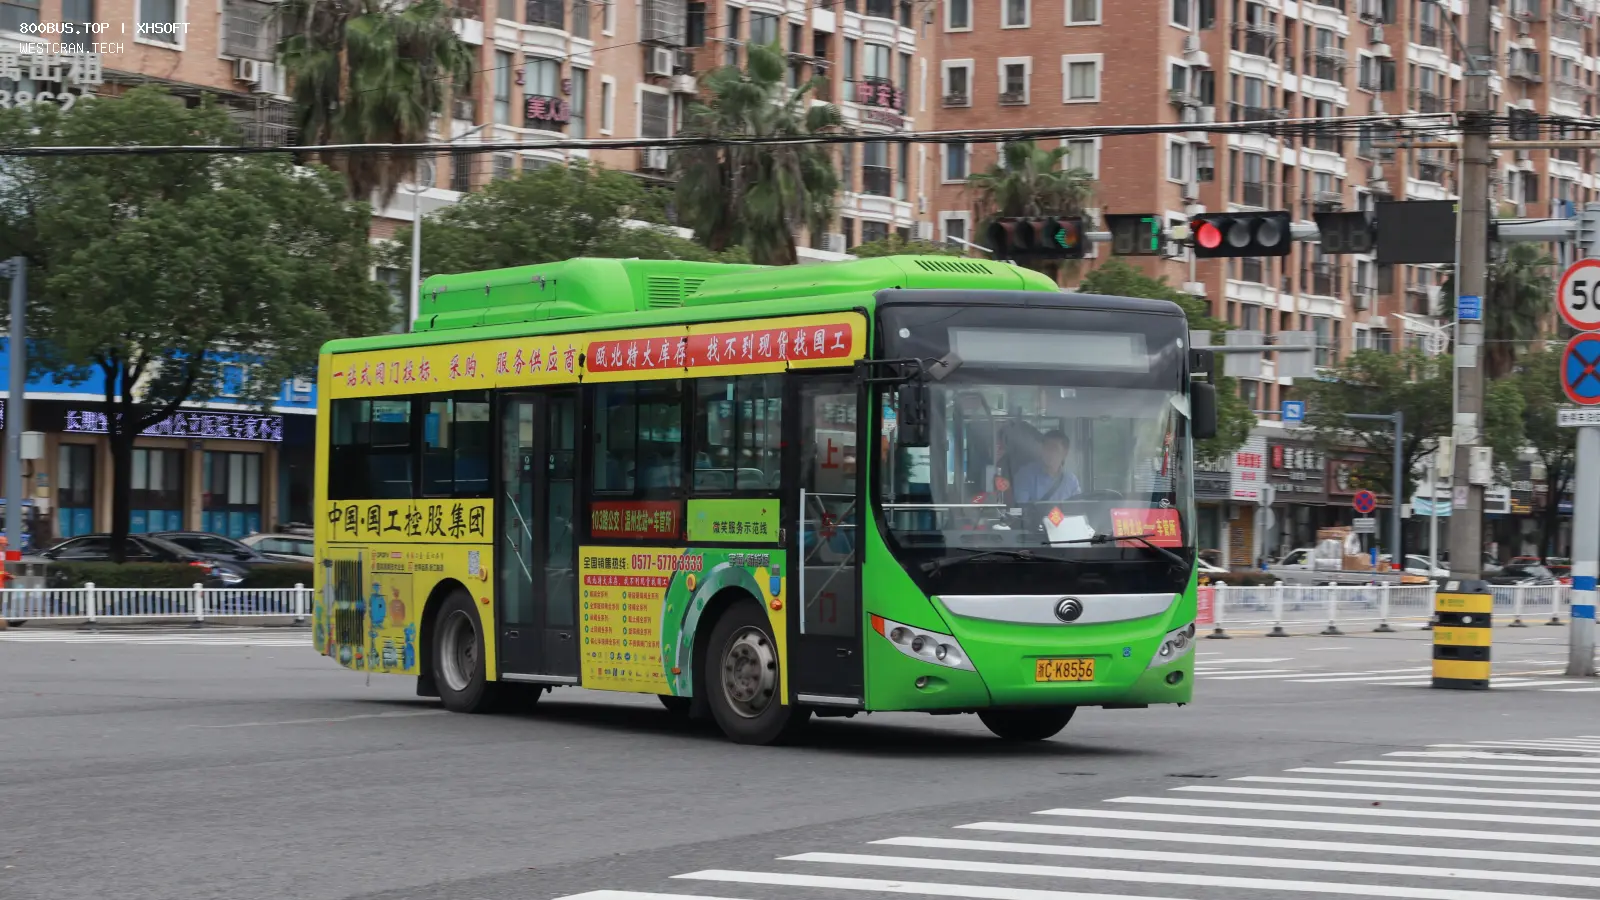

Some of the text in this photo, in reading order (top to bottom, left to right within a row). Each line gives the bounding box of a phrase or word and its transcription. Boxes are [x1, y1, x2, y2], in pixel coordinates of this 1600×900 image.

[328, 502, 486, 540] 中国·国工控股集团
[712, 520, 768, 535] 微笑服务示范线
[631, 553, 703, 572] 0577-57783333
